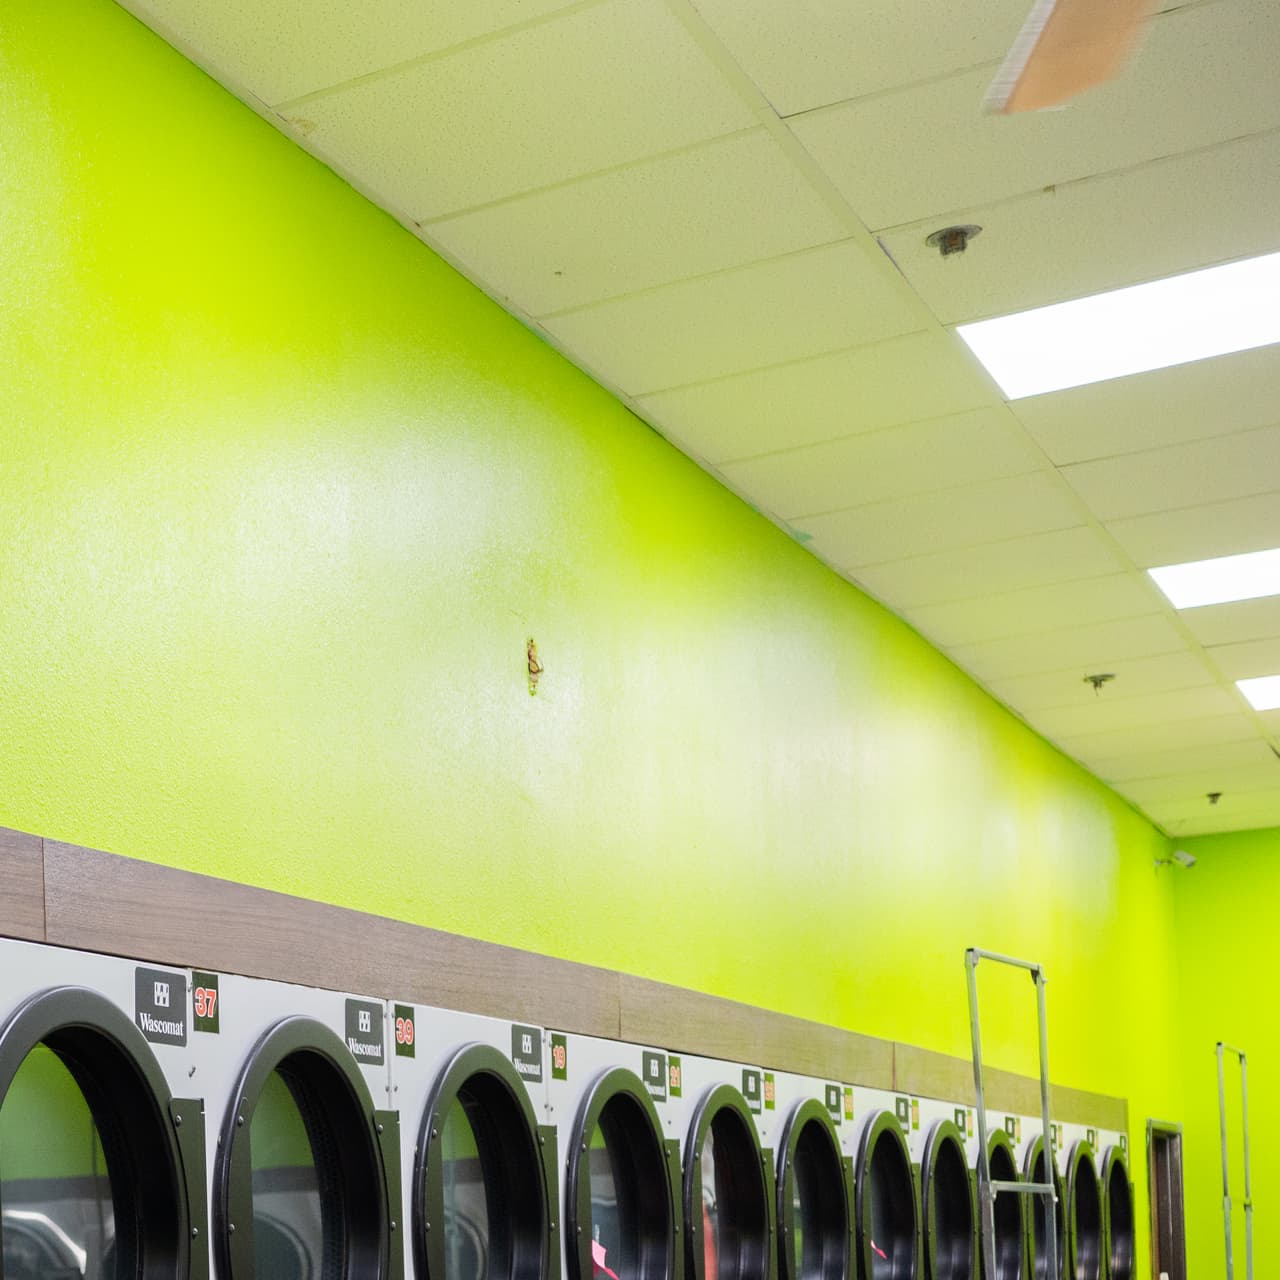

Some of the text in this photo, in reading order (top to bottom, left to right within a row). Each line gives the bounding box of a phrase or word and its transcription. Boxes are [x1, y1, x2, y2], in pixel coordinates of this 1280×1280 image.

[194, 987, 217, 1018] 37
[140, 1012, 184, 1037] Wascomat
[395, 1016, 414, 1045] 39
[348, 1037, 382, 1057] Wascomat
